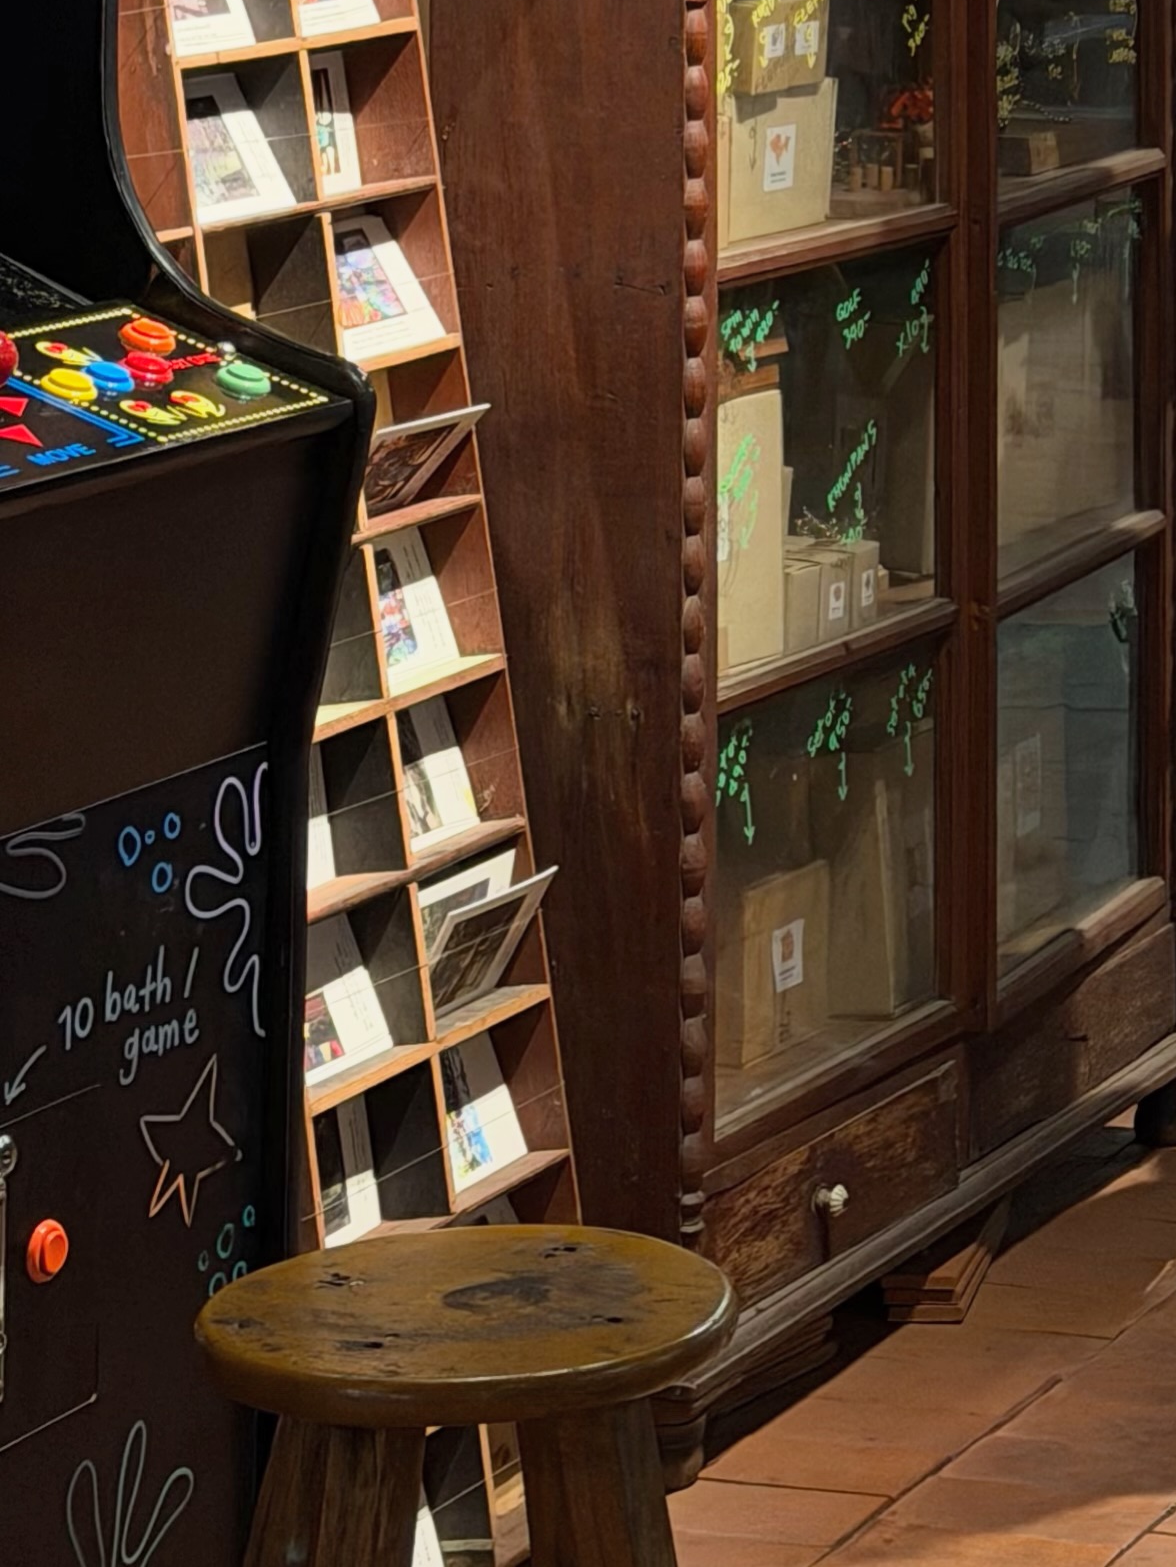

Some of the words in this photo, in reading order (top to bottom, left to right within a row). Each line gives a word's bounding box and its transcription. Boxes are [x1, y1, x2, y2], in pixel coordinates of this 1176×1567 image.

[836, 288, 862, 321] GOLF
[26, 443, 97, 467] MOVE
[57, 997, 95, 1051] 10
[119, 1007, 200, 1086] game
